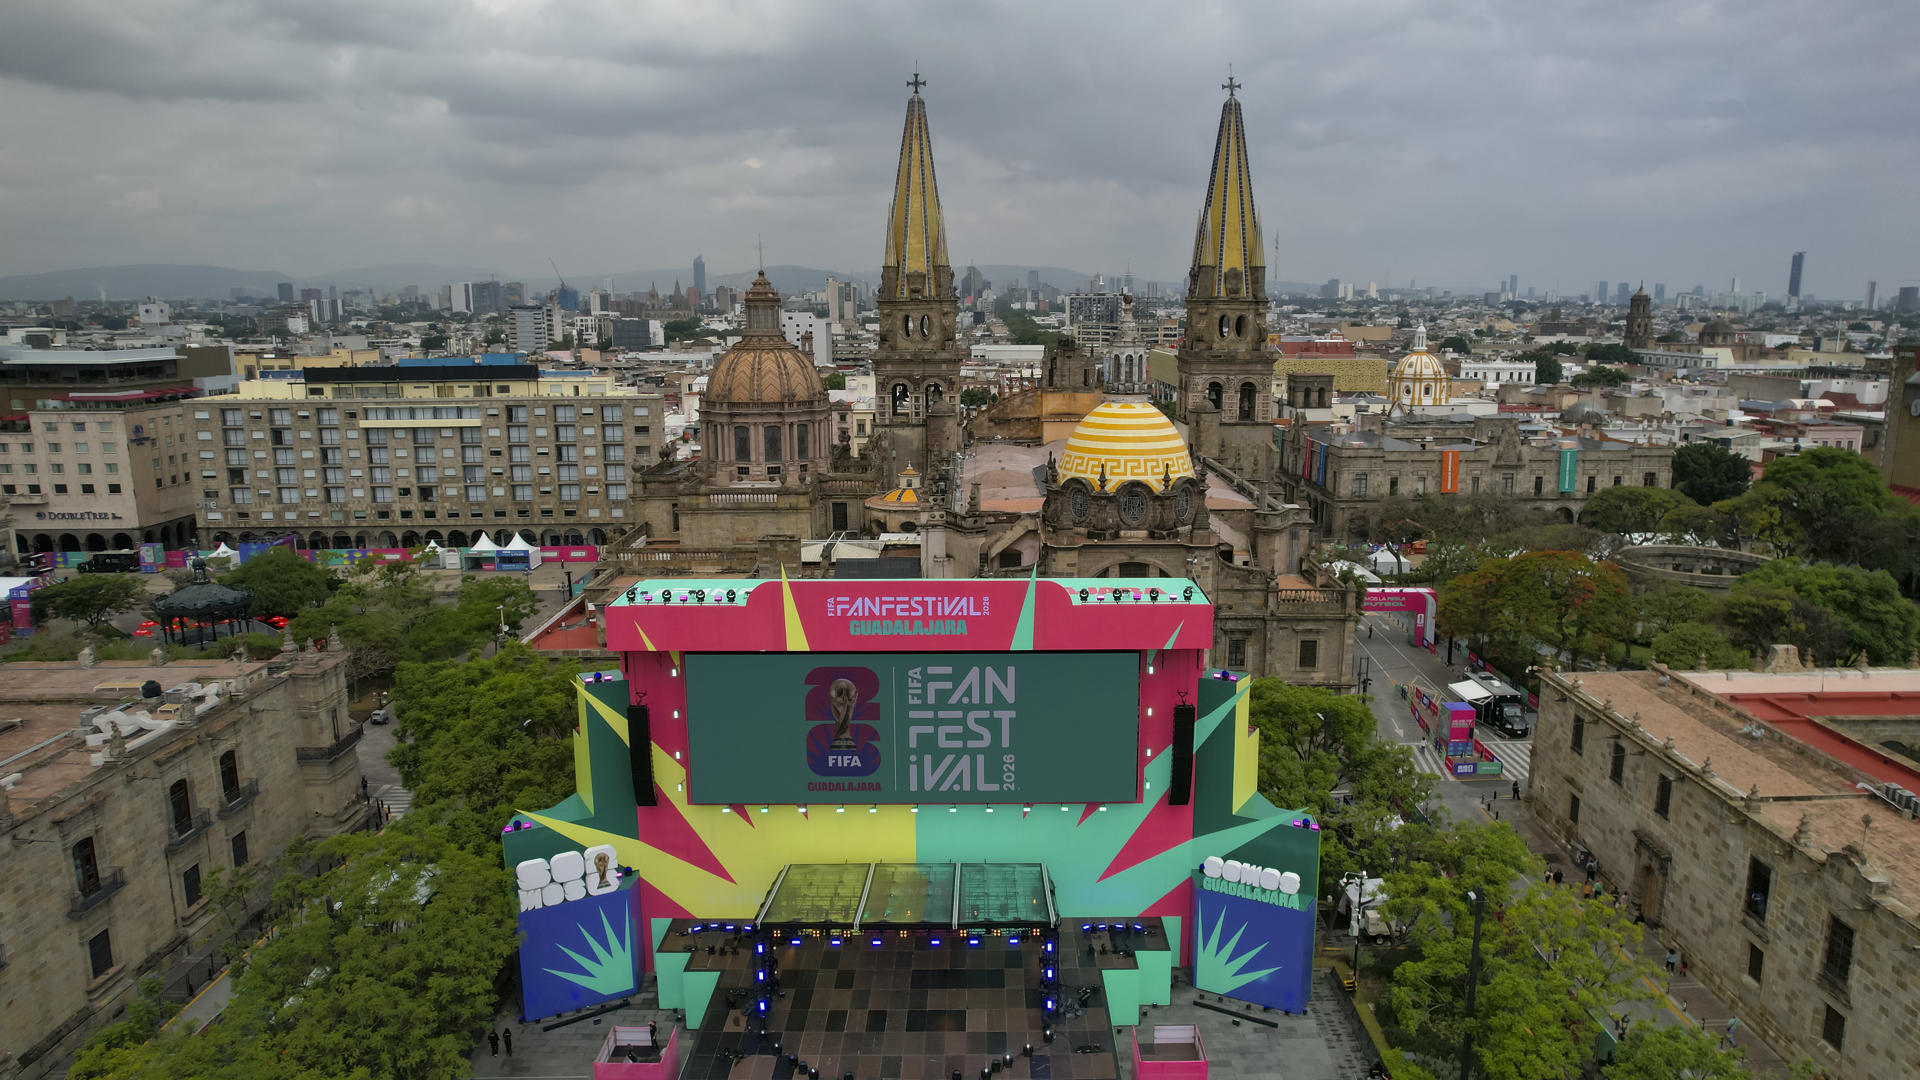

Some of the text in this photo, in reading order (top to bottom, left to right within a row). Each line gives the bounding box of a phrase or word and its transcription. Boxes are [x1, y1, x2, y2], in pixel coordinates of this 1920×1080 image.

[826, 597, 835, 617] FIFA
[982, 596, 990, 616] 2026
[850, 619, 968, 636] GUADALAJARA
[908, 665, 1016, 705] FIFA FAN
[908, 710, 1017, 749] FEST
[827, 754, 862, 768] FIFA
[1002, 753, 1016, 792] 2026
[807, 781, 883, 792] GUADALAJARA
[1202, 876, 1300, 911] GUADALAJARA
